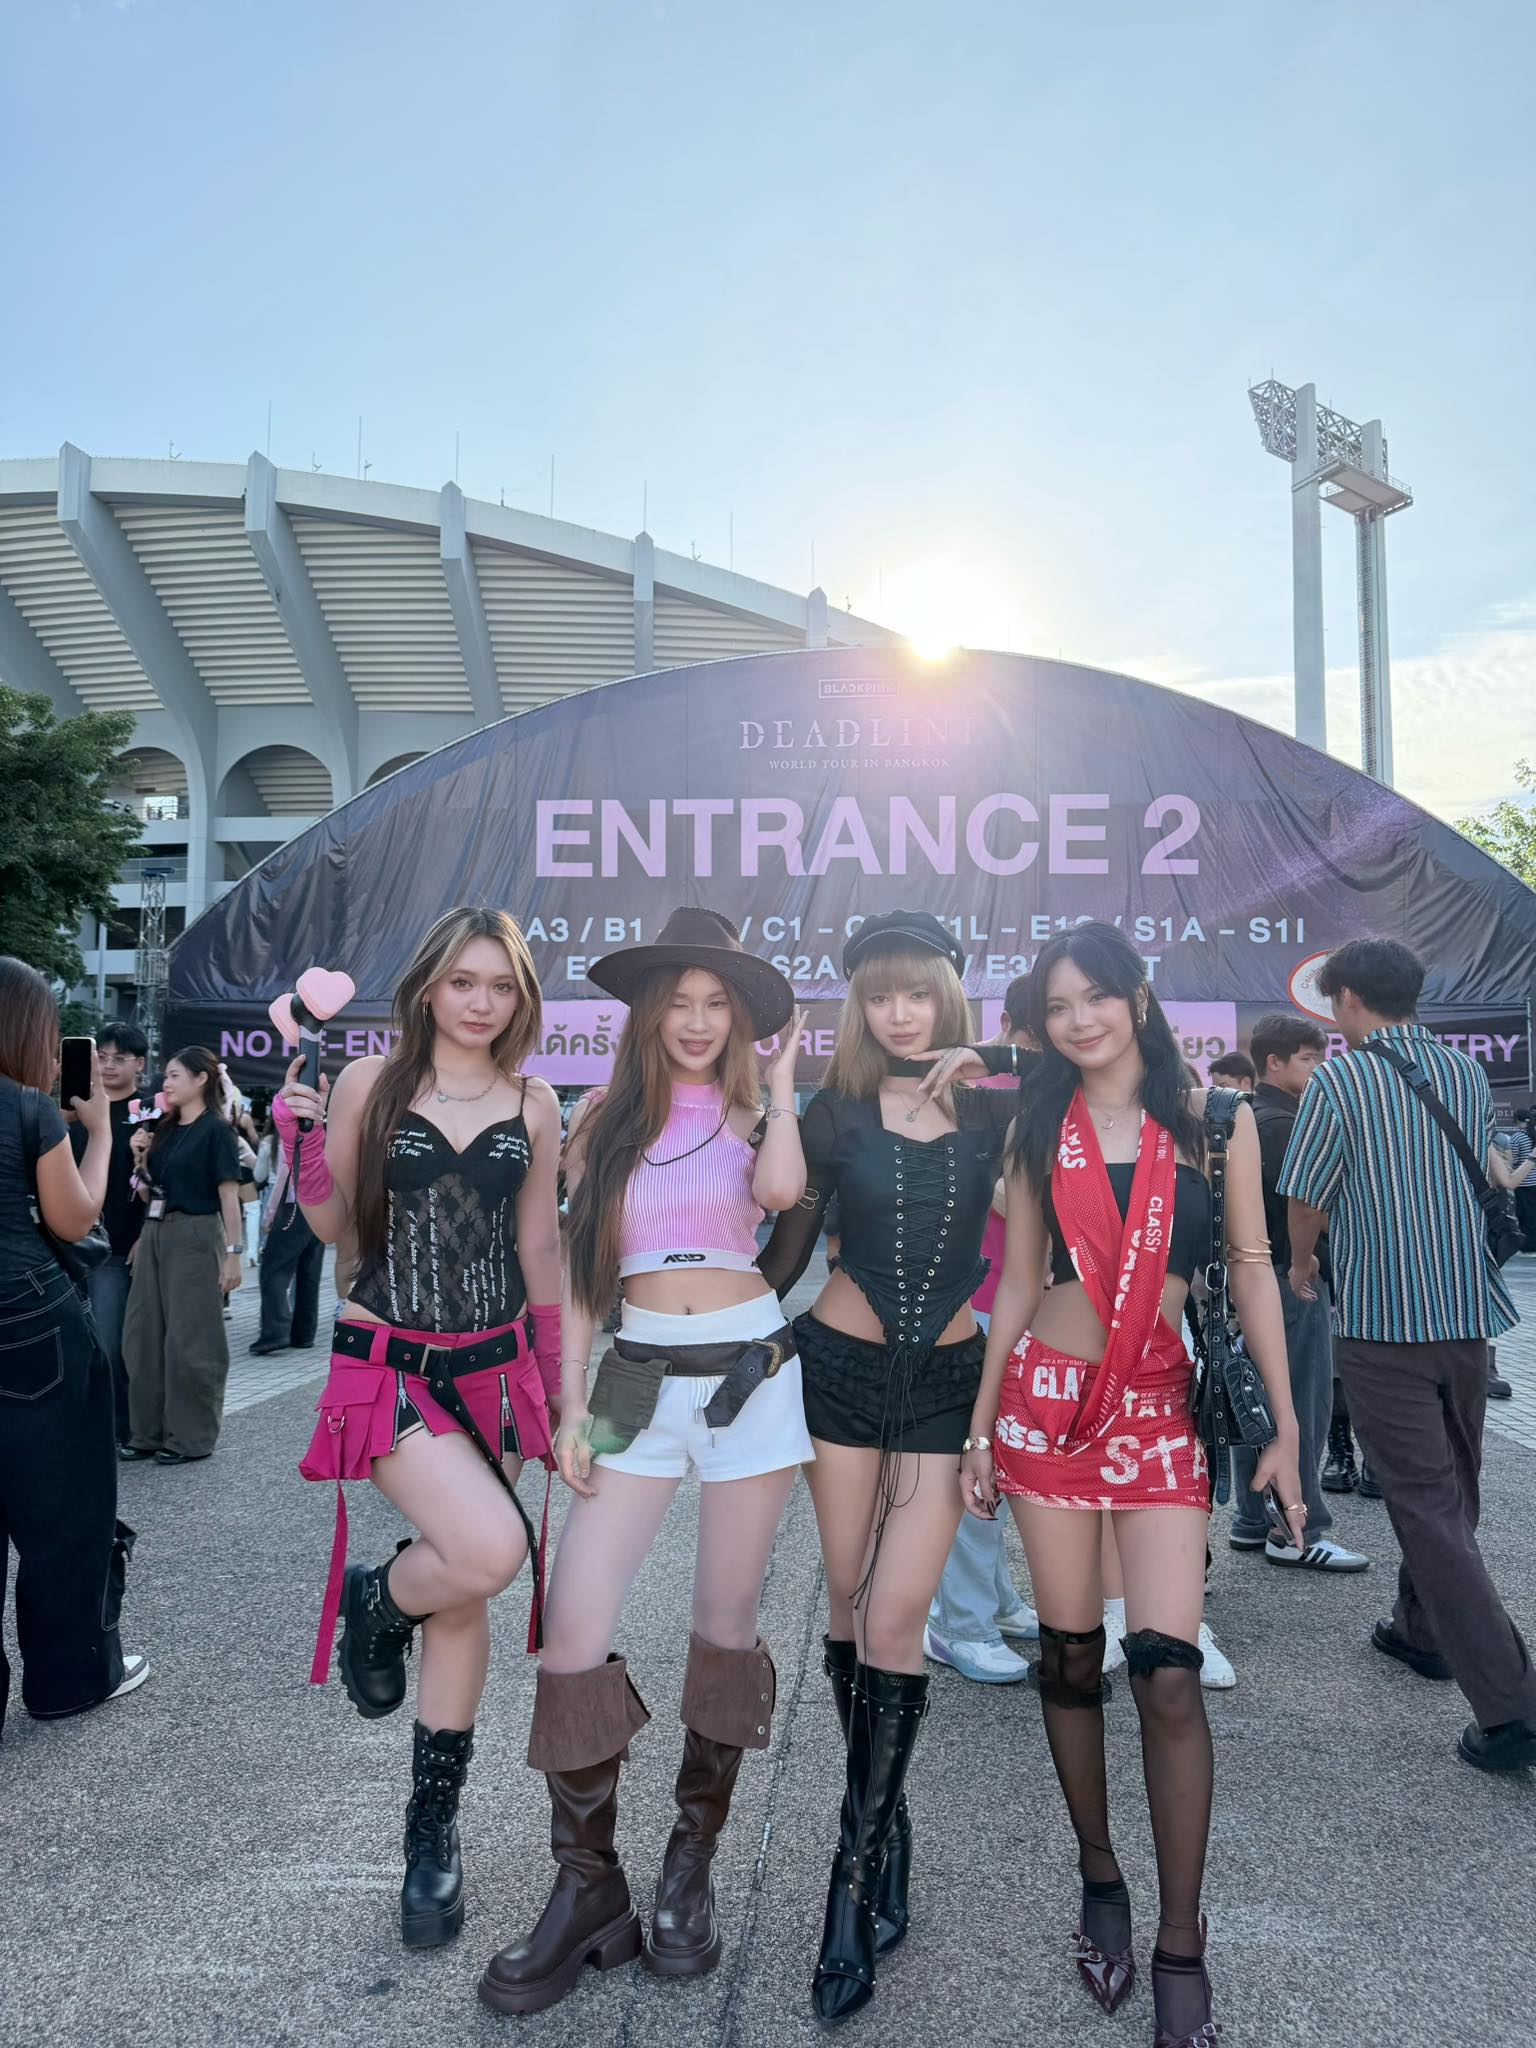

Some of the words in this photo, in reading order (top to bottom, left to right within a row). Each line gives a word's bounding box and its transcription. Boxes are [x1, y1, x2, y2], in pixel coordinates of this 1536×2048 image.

[739, 717, 978, 750] DEADLINE
[769, 758, 817, 769] WORLD
[822, 757, 859, 769] TOUR
[864, 757, 879, 768] IN
[884, 756, 950, 768] BANGKOK
[536, 793, 1110, 877] ENTRANCE
[1141, 794, 1200, 875] 2
[526, 916, 570, 942] A3
[604, 917, 642, 942] B1
[762, 916, 801, 942] C1
[936, 915, 989, 941] 1L
[1134, 916, 1206, 942] S1A
[221, 1030, 272, 1057] NO
[1144, 1195, 1164, 1253] CLASSY
[1032, 1365, 1086, 1401] CLA
